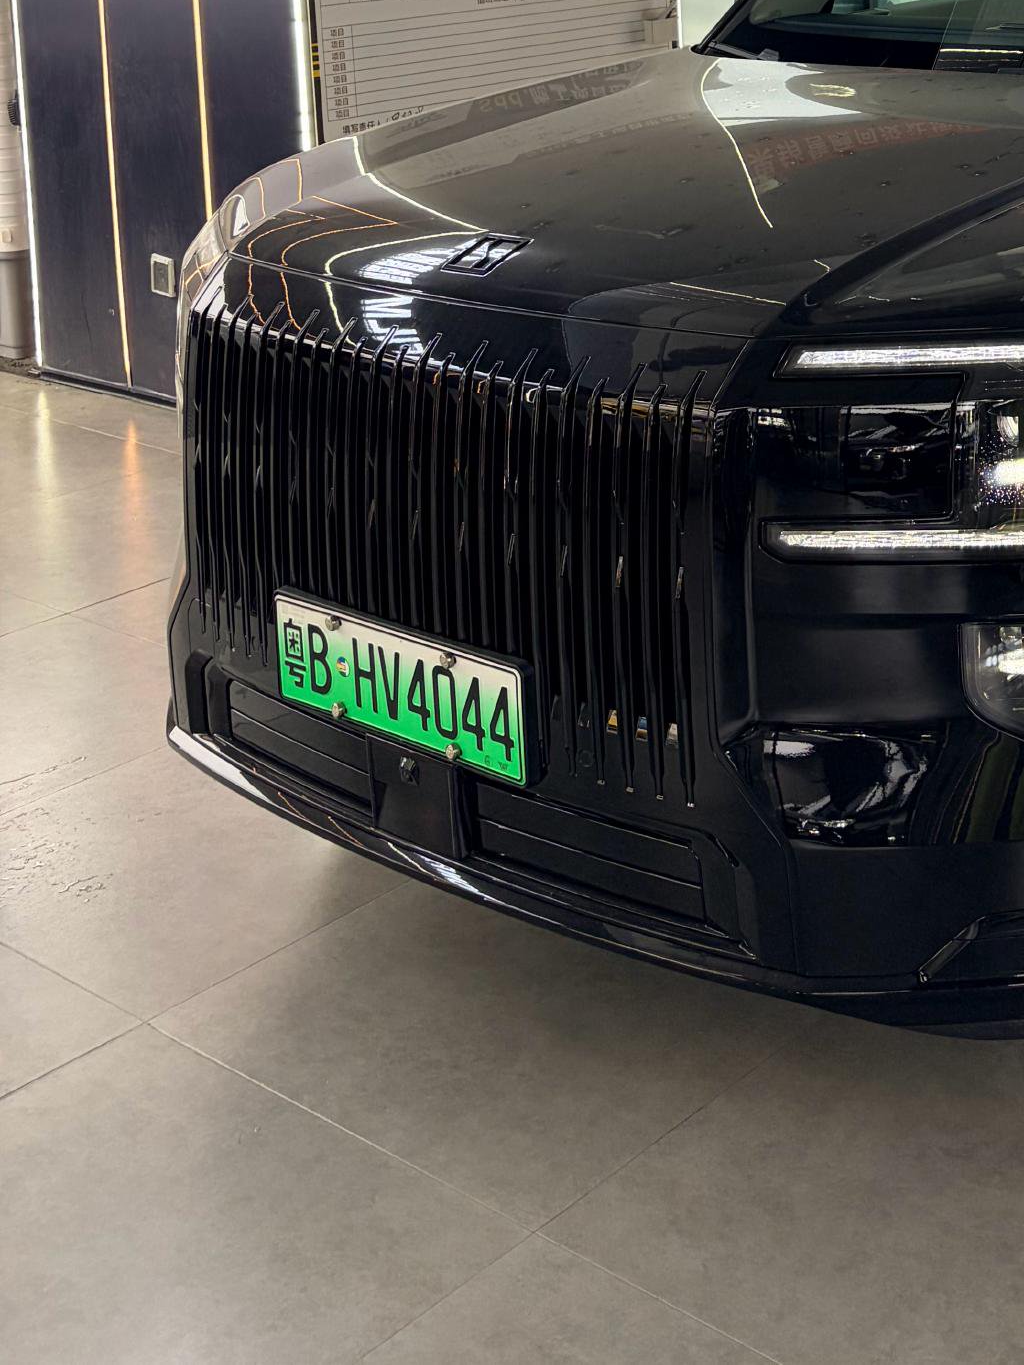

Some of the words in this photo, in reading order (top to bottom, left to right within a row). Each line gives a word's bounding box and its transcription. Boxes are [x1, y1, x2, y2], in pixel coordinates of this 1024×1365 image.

[330, 28, 344, 36] 项目
[331, 40, 345, 48] 项目
[332, 52, 345, 60] 项目
[332, 63, 346, 71] 项目
[333, 75, 347, 83] 项目
[334, 86, 348, 94] 项目
[335, 98, 349, 106] 项目
[336, 109, 349, 117] 项目
